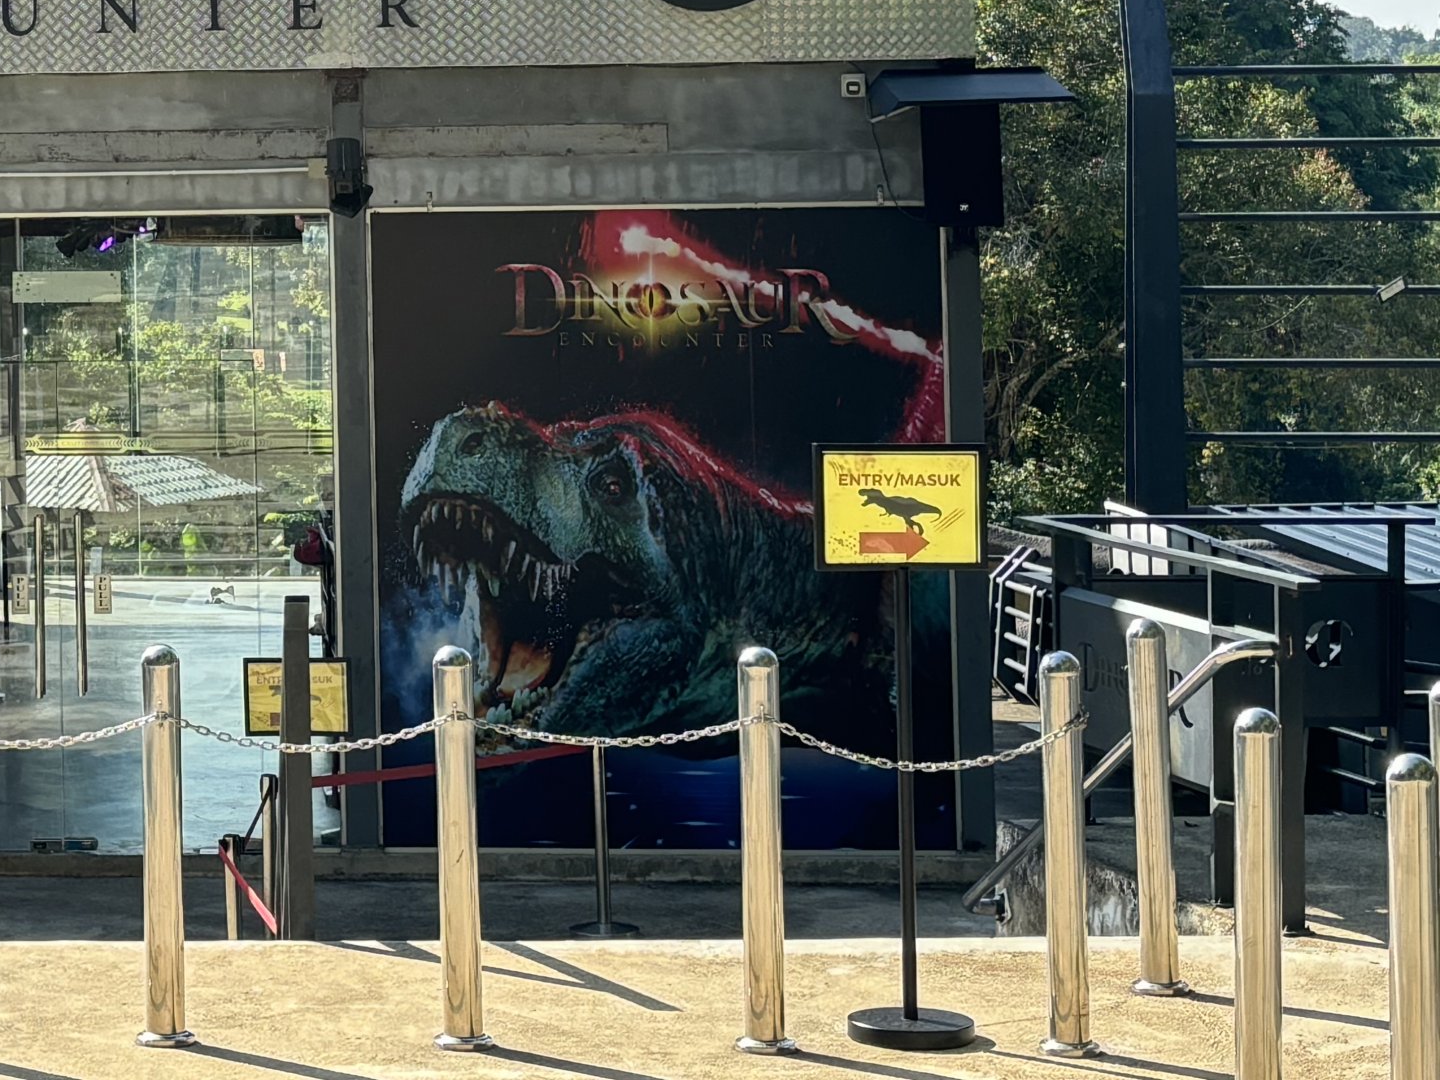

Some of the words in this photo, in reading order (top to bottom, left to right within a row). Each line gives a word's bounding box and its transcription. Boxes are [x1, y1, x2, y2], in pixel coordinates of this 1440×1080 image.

[495, 263, 860, 344] DINOSAUR
[560, 331, 775, 349] ENCOUNTER
[838, 472, 961, 488] ENTRY/MASUK
